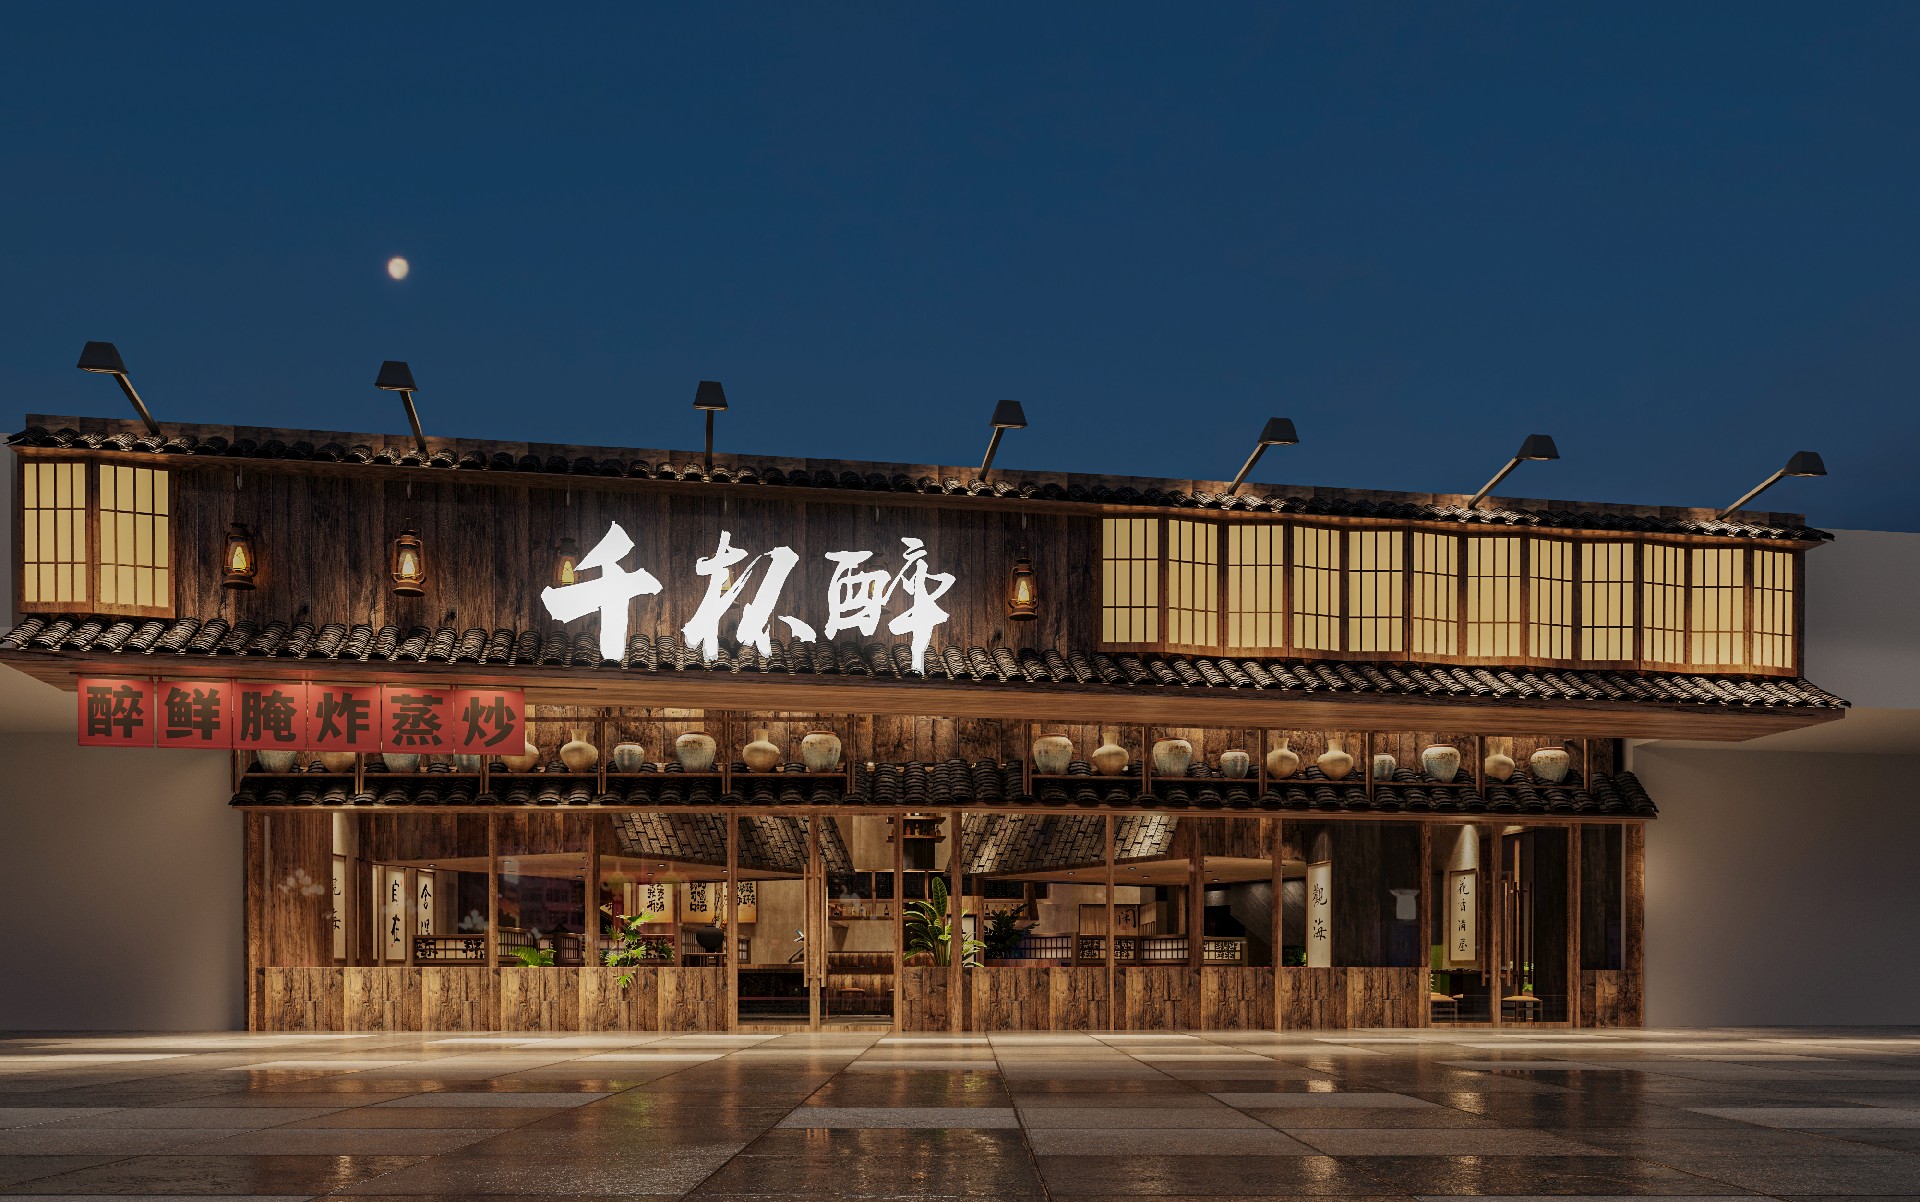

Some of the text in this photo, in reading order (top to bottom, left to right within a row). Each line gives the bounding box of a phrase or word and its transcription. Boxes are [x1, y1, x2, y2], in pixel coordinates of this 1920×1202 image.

[541, 521, 956, 675] 千杯醉
[86, 684, 518, 748] 醉鲜腌炸蒸炒
